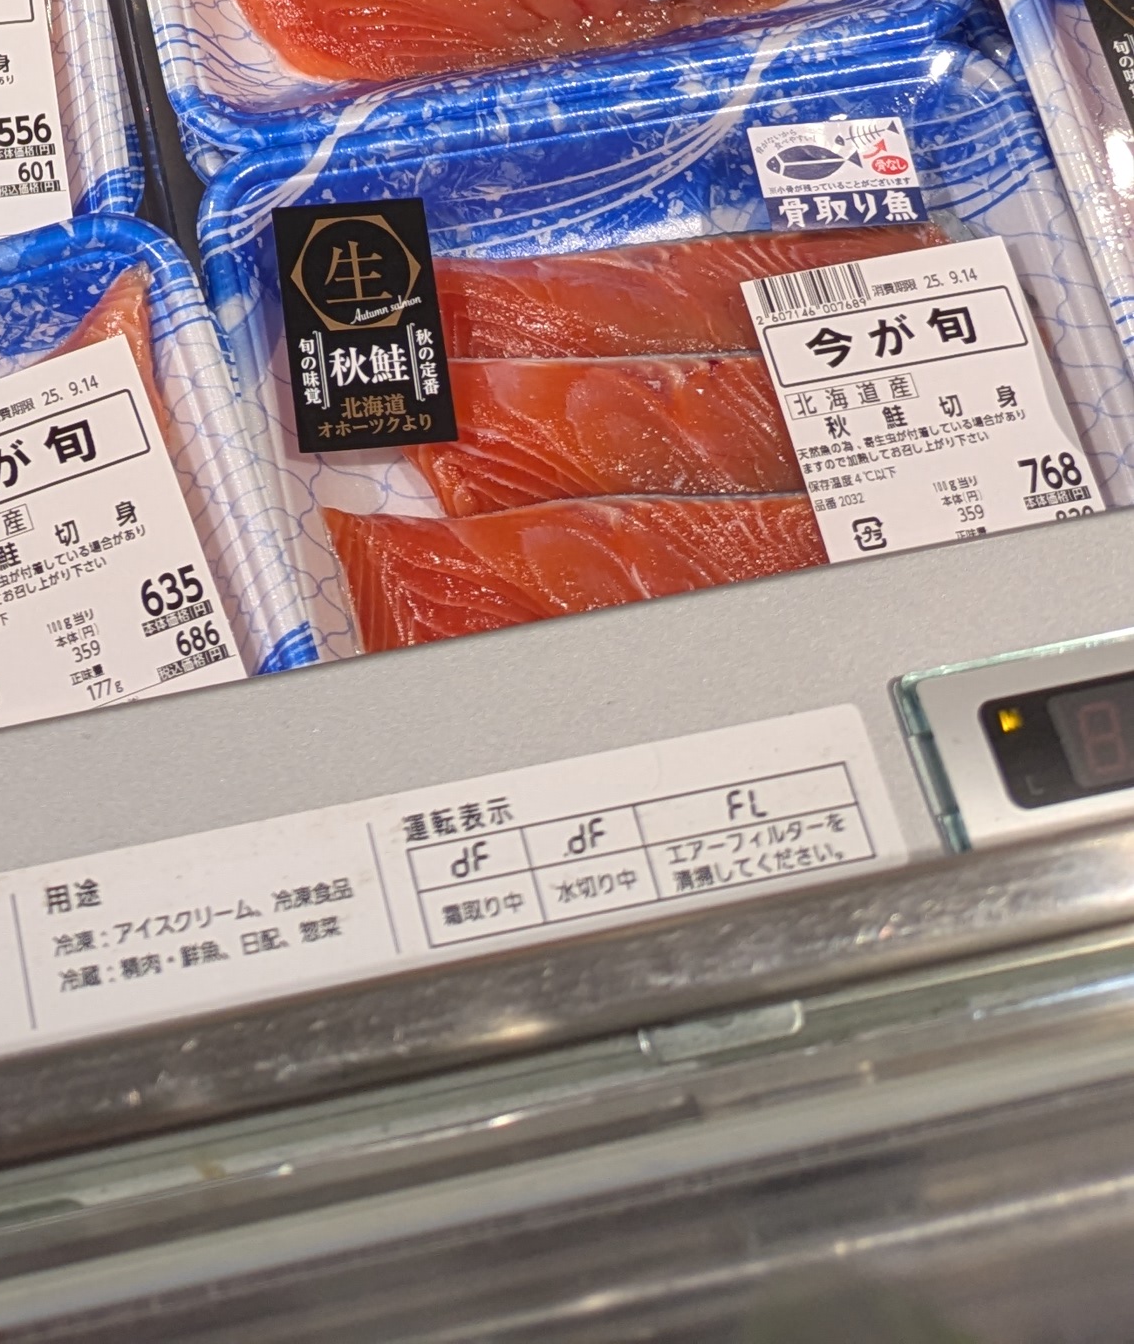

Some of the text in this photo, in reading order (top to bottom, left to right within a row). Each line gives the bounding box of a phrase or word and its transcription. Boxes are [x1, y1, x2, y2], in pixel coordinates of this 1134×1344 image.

[17, 160, 56, 183] 601
[777, 190, 919, 230] 骨取り魚
[322, 242, 387, 307] 生
[801, 300, 981, 372] 今が旬
[297, 338, 324, 406] 旬の味覚
[328, 343, 412, 388] 秋鮭
[414, 328, 442, 398] 秋の定番
[317, 416, 435, 441] オホーツクより
[340, 394, 408, 420] 北海道
[1018, 451, 1084, 494] 768
[136, 563, 205, 619] 635
[172, 620, 220, 659] 686
[402, 797, 515, 844] 運転表示
[727, 789, 768, 821] FL
[666, 813, 846, 866] エアーフィルターを
[46, 880, 102, 913] 用途
[553, 870, 639, 904] 水切り中
